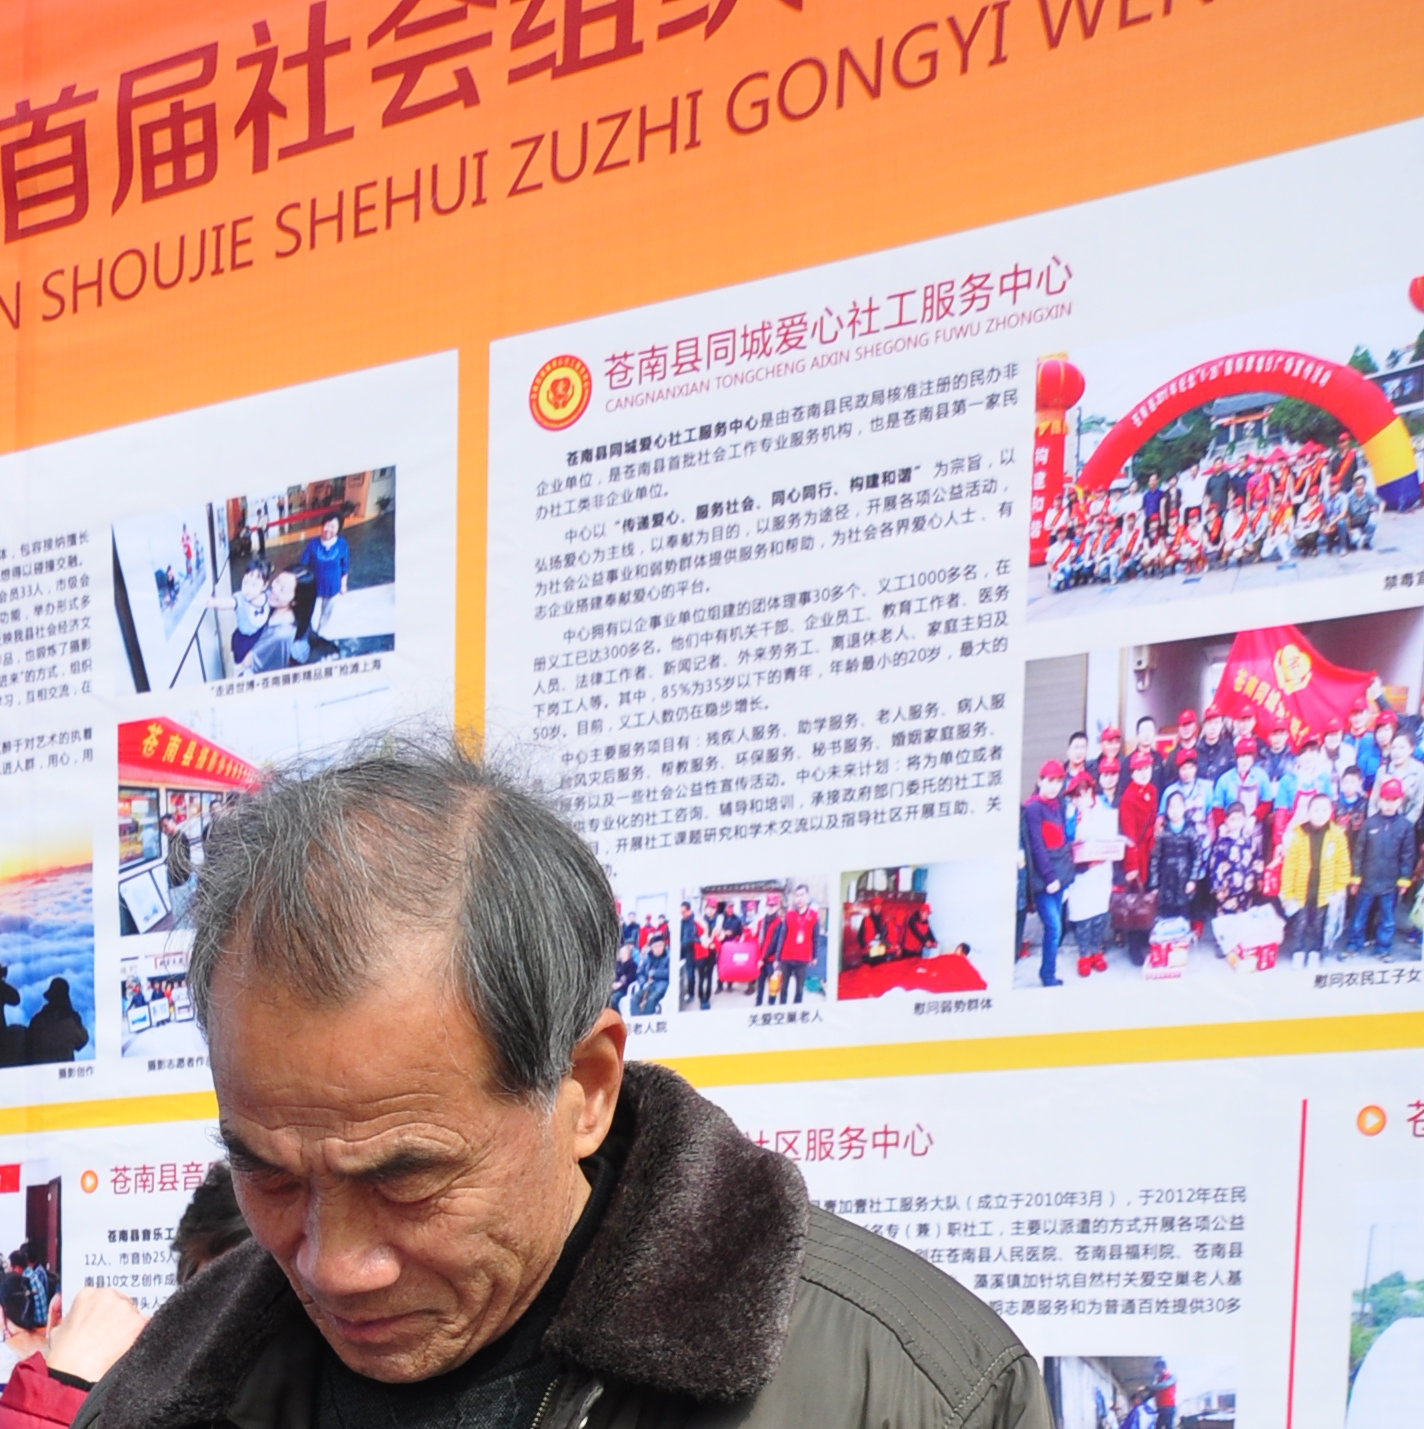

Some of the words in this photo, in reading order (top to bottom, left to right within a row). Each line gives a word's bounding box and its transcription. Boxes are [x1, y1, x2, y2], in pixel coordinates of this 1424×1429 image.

[41, 215, 254, 323] SHOUJIE
[274, 150, 488, 260] SHEHUI
[508, 89, 703, 199] ZUZHI
[725, 0, 1010, 136] GONGYI
[604, 255, 1074, 392] 苍南县同城爱心社工服务中心
[605, 379, 711, 414] CANGNANXIAN
[715, 359, 807, 391] TONGCHENG
[810, 349, 851, 374] AIXIN
[855, 331, 930, 362] SHEGONG
[934, 321, 981, 345] FUWU
[986, 301, 1073, 335] ZHONGXIN
[147, 1056, 212, 1073] 摄影志愿者作
